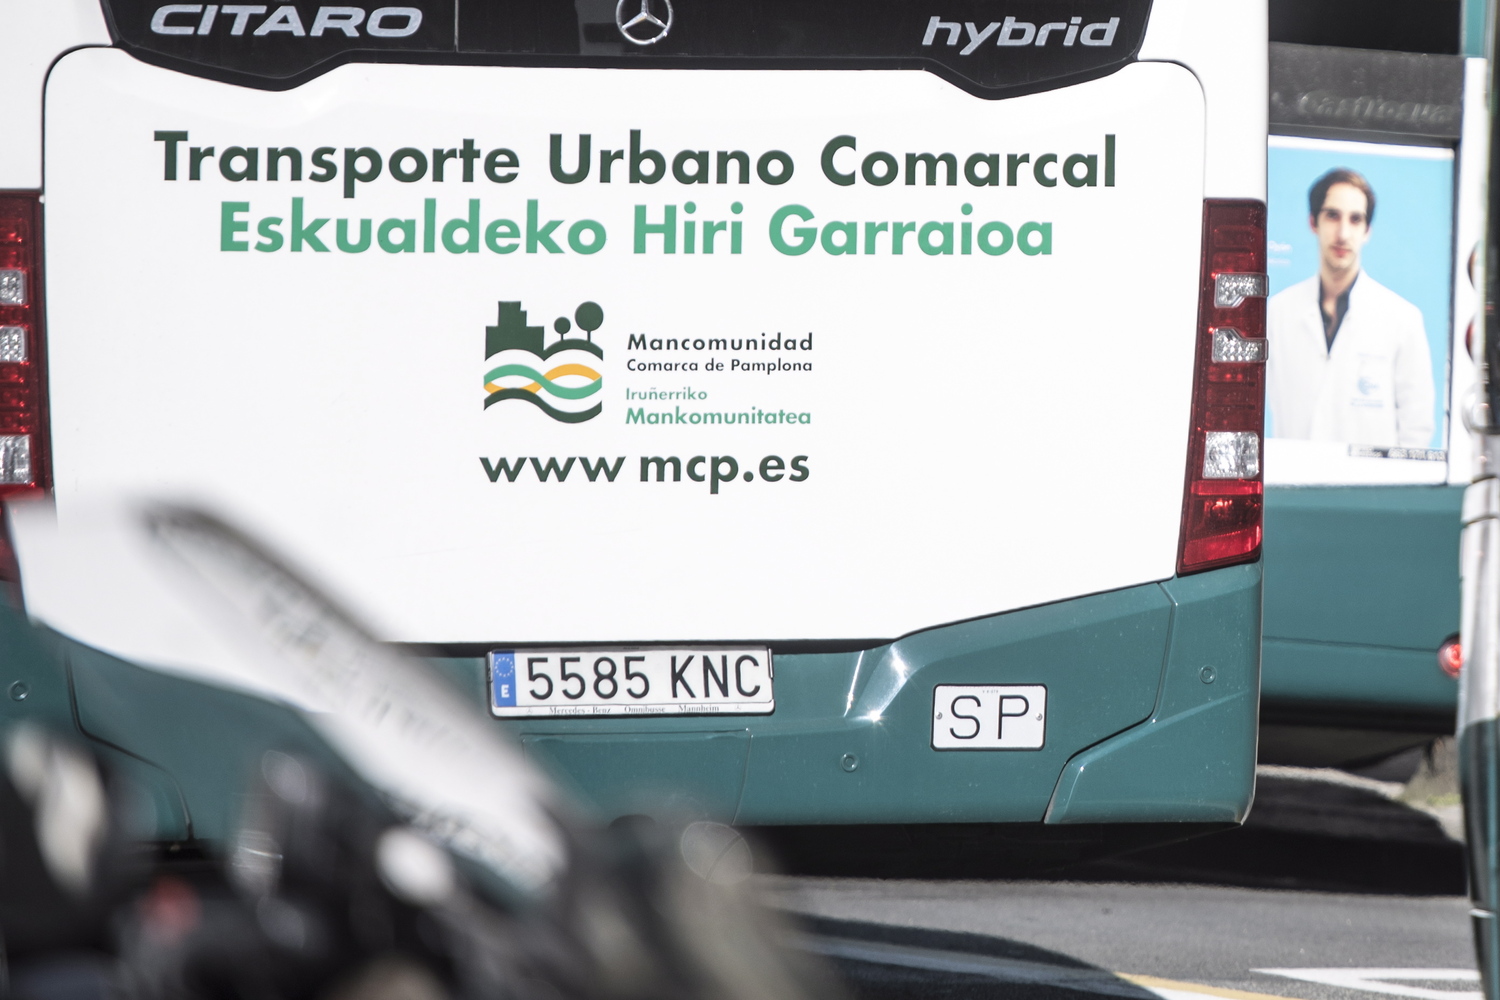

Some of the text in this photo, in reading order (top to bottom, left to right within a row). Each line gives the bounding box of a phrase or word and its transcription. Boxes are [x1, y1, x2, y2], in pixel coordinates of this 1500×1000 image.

[151, 4, 423, 38] CITARO
[922, 16, 1120, 56] hybrid
[154, 129, 1117, 198] Transporte Urbano Comarcal
[219, 196, 1054, 257] Eskualdeko Hiri Garraioa
[627, 333, 814, 352] Mancomunidad
[627, 358, 814, 376] Comarca de Pamplona
[626, 386, 708, 401] Iruñerriko
[626, 406, 812, 426] Mankomunitatea
[479, 455, 811, 495] www mcp.es
[501, 654, 761, 701] E 5585 KNC
[549, 706, 585, 715] Mercedes
[592, 706, 611, 714] Benz
[678, 704, 720, 713] Mannheim
